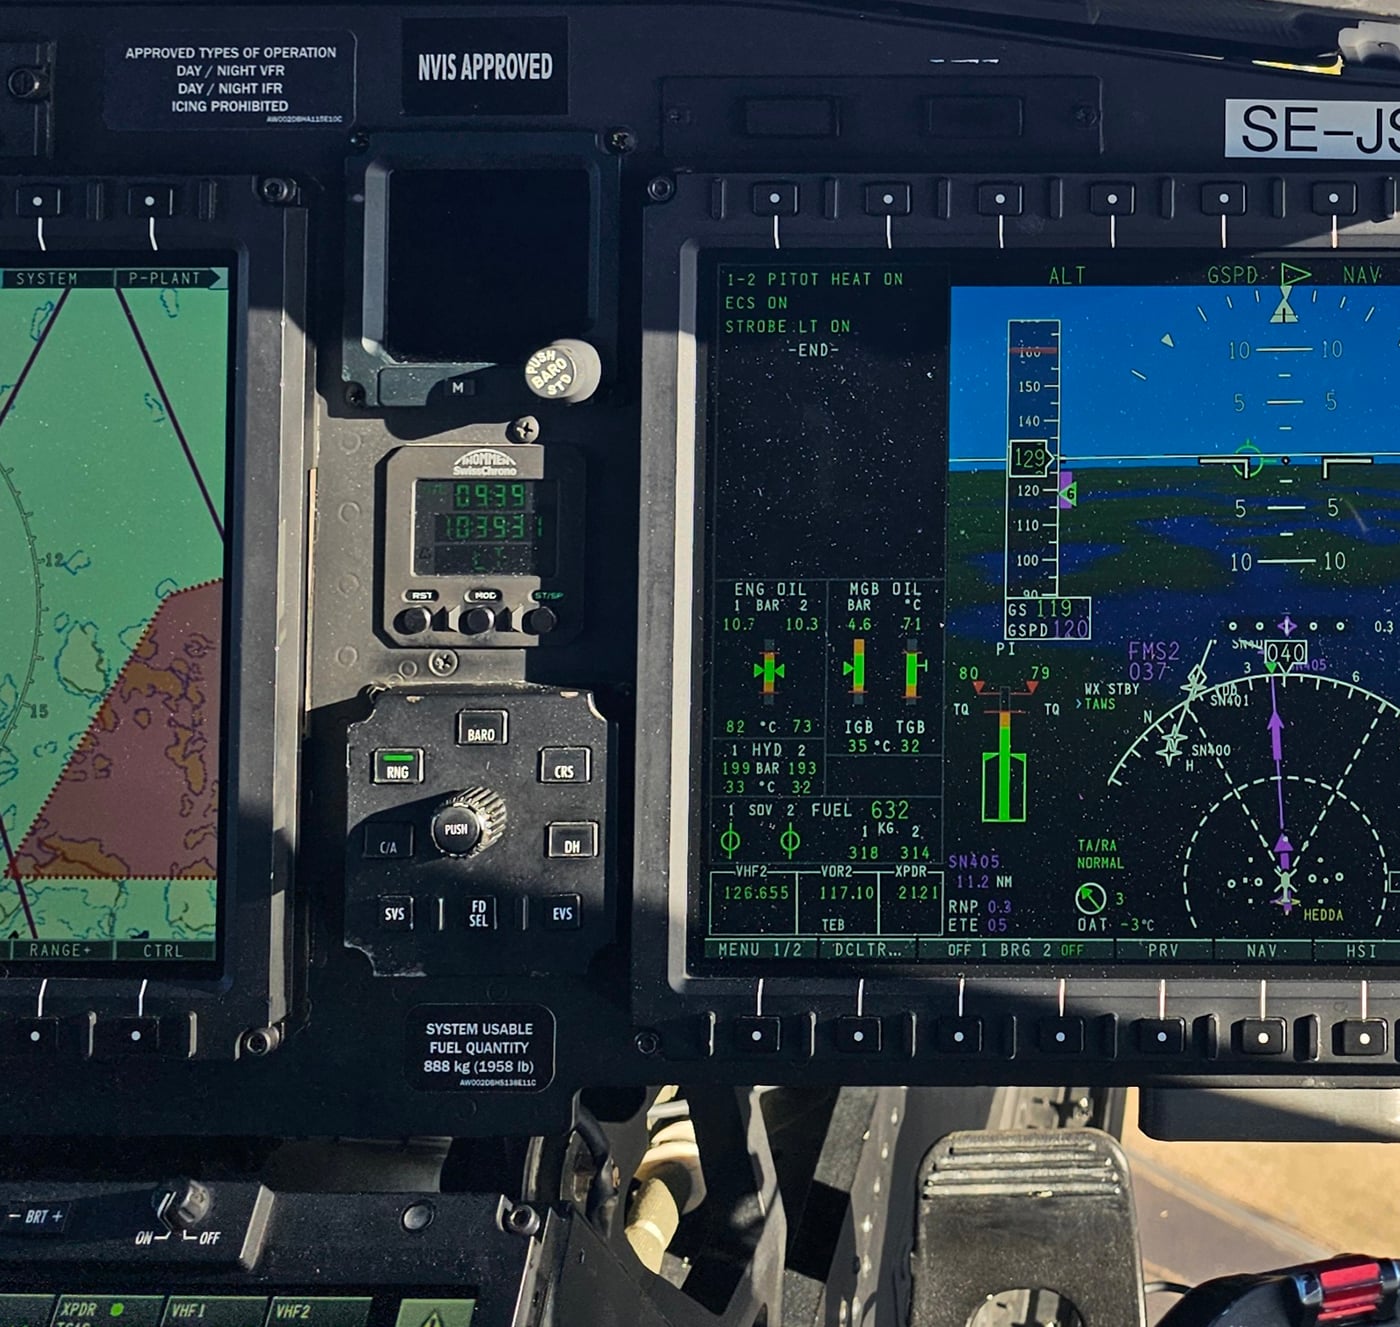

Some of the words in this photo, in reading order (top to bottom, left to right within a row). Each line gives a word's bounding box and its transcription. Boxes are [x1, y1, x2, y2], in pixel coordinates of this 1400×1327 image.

[126, 47, 195, 58] APPROVED
[199, 47, 239, 58] TYPES
[243, 47, 260, 58] OF
[264, 47, 336, 58] OPERATION
[177, 66, 202, 76] DAY
[217, 65, 257, 76] NIGHT
[260, 65, 285, 76] VFR
[418, 54, 456, 82] NVIS
[460, 52, 553, 81] APPROVED
[179, 83, 204, 94] DAY
[219, 83, 258, 94] NIGHT
[262, 83, 283, 94] IFR
[172, 101, 207, 112] ICING
[211, 101, 288, 112] PROHIBITED
[16, 272, 78, 286] SYSTEM
[129, 272, 200, 286] P-PLANT
[768, 273, 819, 285] PITOT
[832, 273, 871, 285] HEAT
[884, 273, 903, 285] ON
[1049, 266, 1086, 284] ALT
[1208, 266, 1257, 284] GSPD
[1344, 266, 1381, 283] NAV
[726, 297, 755, 309] ECS
[768, 297, 788, 309] ON
[726, 320, 786, 333] STROBE
[800, 320, 818, 332] LT
[831, 320, 850, 332] ON
[526, 350, 555, 375] PUSH
[531, 358, 567, 389] BARO
[452, 382, 464, 393] M
[547, 374, 571, 395] STD
[1019, 381, 1041, 392] 150
[1016, 448, 1045, 468] 129
[735, 583, 765, 596] ENG
[777, 583, 806, 596] OIL
[850, 583, 880, 595] MGB
[893, 583, 922, 595] OIL
[1037, 600, 1072, 617] 119
[1008, 624, 1048, 636] GSPD
[1129, 641, 1179, 660] FMS2
[1268, 644, 1305, 662] 040
[1129, 662, 1166, 680] 037
[1108, 683, 1139, 694] STBY
[1086, 698, 1116, 709] TAWS
[468, 729, 495, 741] BARO
[753, 743, 782, 756] HYD
[387, 766, 409, 778] RNG
[555, 766, 574, 778] CRS
[756, 763, 779, 774] BAR
[812, 803, 852, 817] FUEL
[872, 801, 909, 819] 632
[445, 824, 467, 835] PUSH
[380, 842, 397, 854] C/A
[565, 841, 580, 853] DH
[1078, 840, 1117, 851] TA/RA
[949, 856, 999, 868] SN405
[1077, 857, 1124, 869] NORMAL
[736, 866, 767, 877] VHF2
[895, 866, 927, 877] XPDR
[725, 886, 789, 899] 126.655
[820, 887, 874, 899] 117.10
[898, 886, 938, 899] 2121
[472, 901, 486, 912] FD
[949, 901, 978, 913] RNP
[385, 908, 405, 920] SVS
[553, 908, 572, 920] EVS
[1304, 909, 1344, 921] HEDDA
[469, 916, 488, 927] SEL
[822, 919, 845, 930] TEB
[143, 944, 184, 958] CTRL
[719, 943, 759, 956] MENU
[774, 944, 801, 956] 1/2
[1247, 945, 1277, 957] NAV
[1347, 945, 1376, 957] HSI
[426, 1023, 478, 1035] SYSTEM
[483, 1023, 533, 1035] USABLE
[430, 1042, 462, 1054] FUEL
[466, 1042, 529, 1055] QUANTITY
[424, 1061, 450, 1072] 888
[454, 1060, 470, 1074] kg
[474, 1061, 513, 1074] (1958
[518, 1061, 534, 1074] lb)
[26, 1210, 49, 1224] BRT
[136, 1231, 153, 1245] ON
[200, 1231, 220, 1245] OFF
[61, 1303, 97, 1317] XPDR
[172, 1304, 205, 1318] VHF1
[277, 1305, 310, 1318] VHF2
